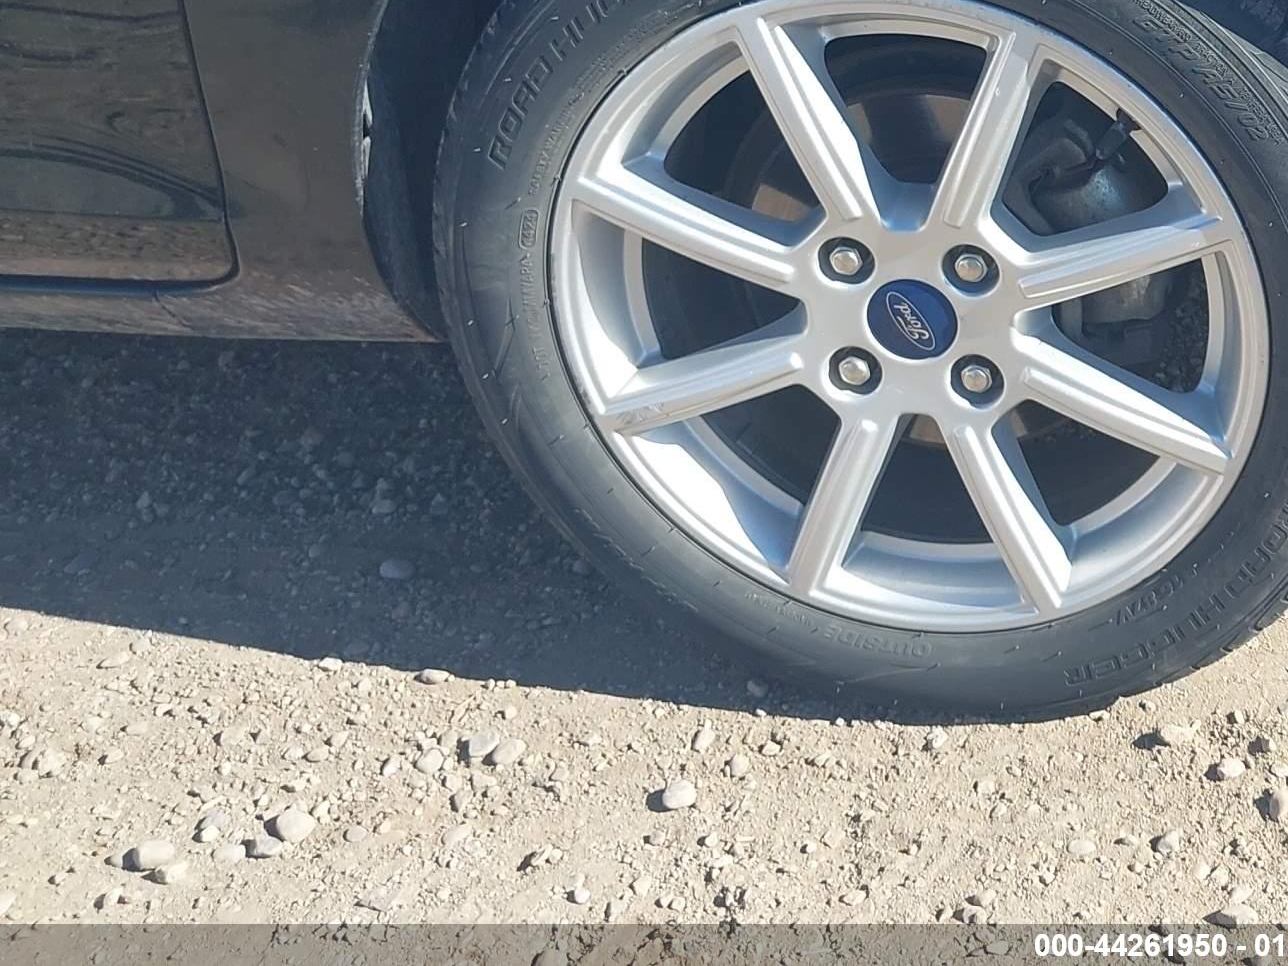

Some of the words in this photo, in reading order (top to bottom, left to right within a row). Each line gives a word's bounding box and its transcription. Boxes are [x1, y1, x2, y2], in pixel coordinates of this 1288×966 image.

[488, 57, 553, 169] ROAD
[894, 302, 930, 340] Ford
[824, 626, 932, 657] OUTSIDE
